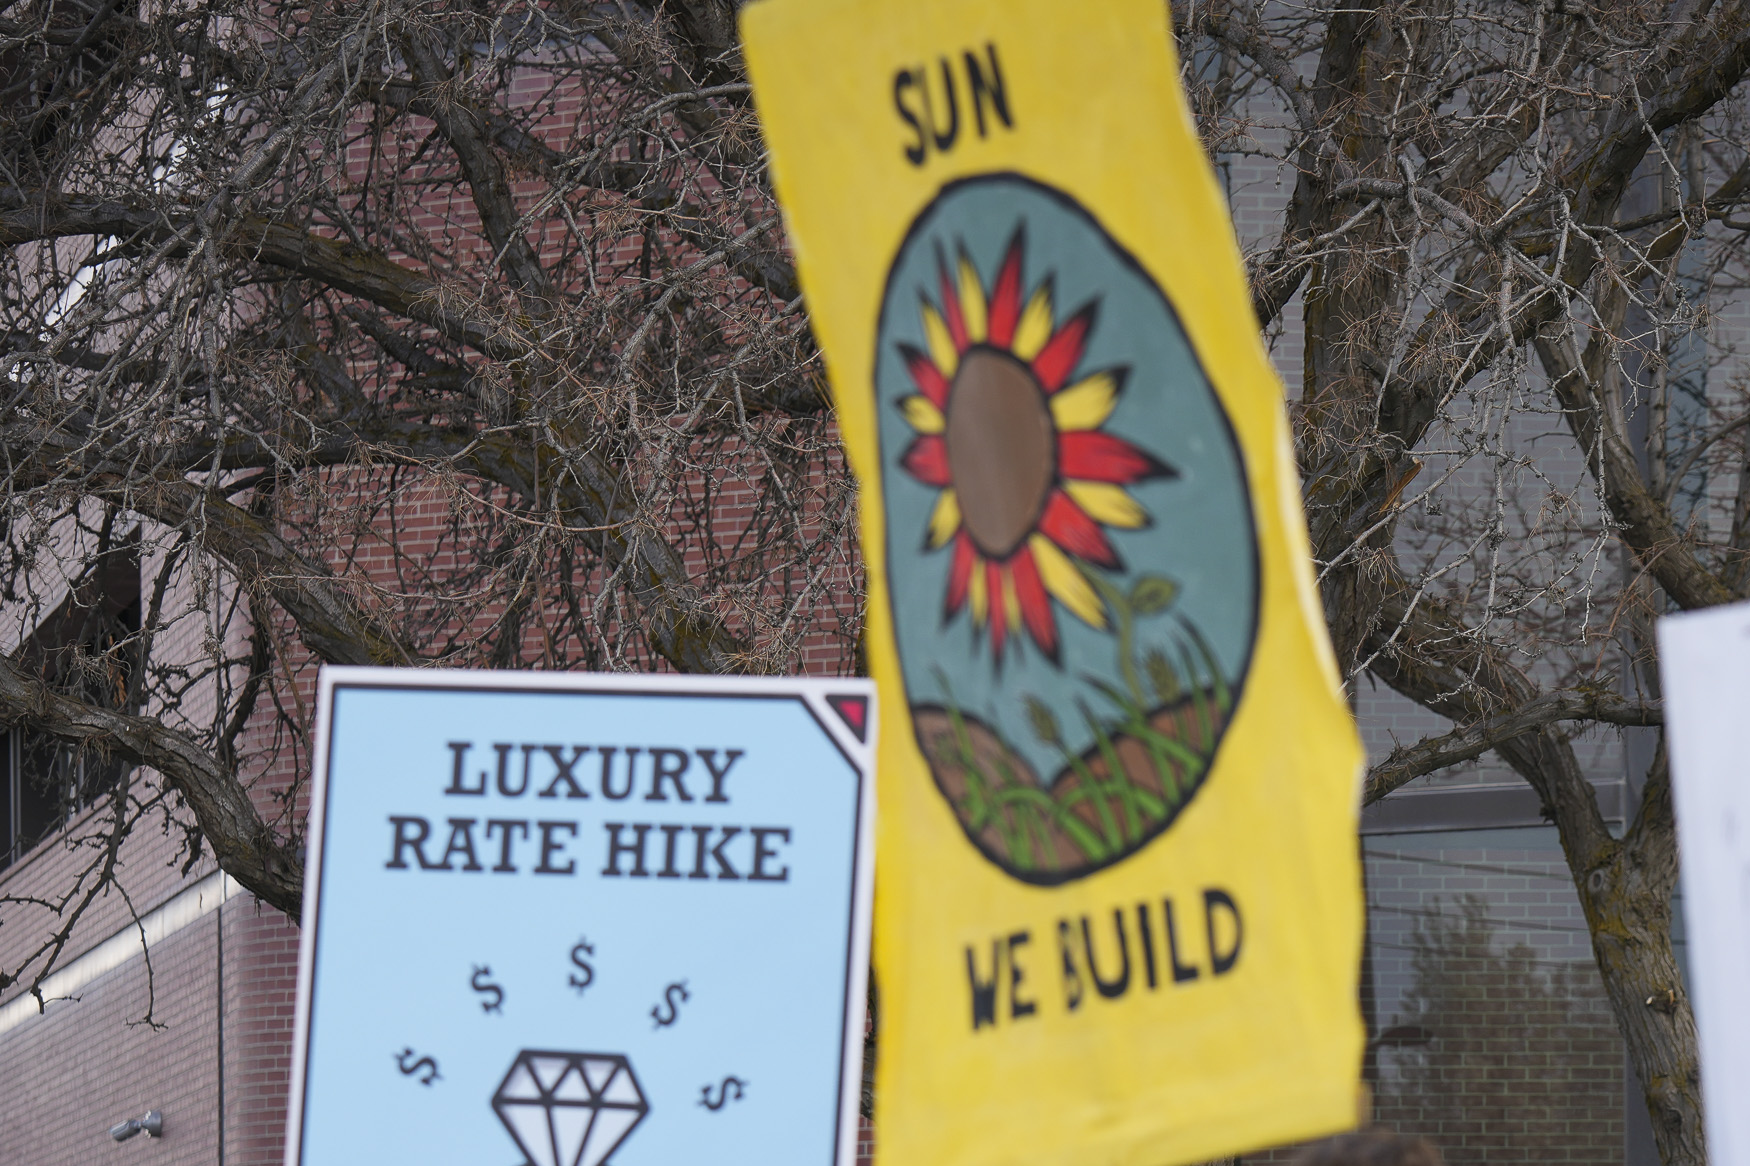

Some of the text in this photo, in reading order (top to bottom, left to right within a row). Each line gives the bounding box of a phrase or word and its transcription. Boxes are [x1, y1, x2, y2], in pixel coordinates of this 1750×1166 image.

[891, 41, 1015, 167] SUN
[444, 741, 745, 803] LUXURY
[384, 815, 792, 883] RATE HIKE
[963, 886, 1245, 1034] WE BUILD
